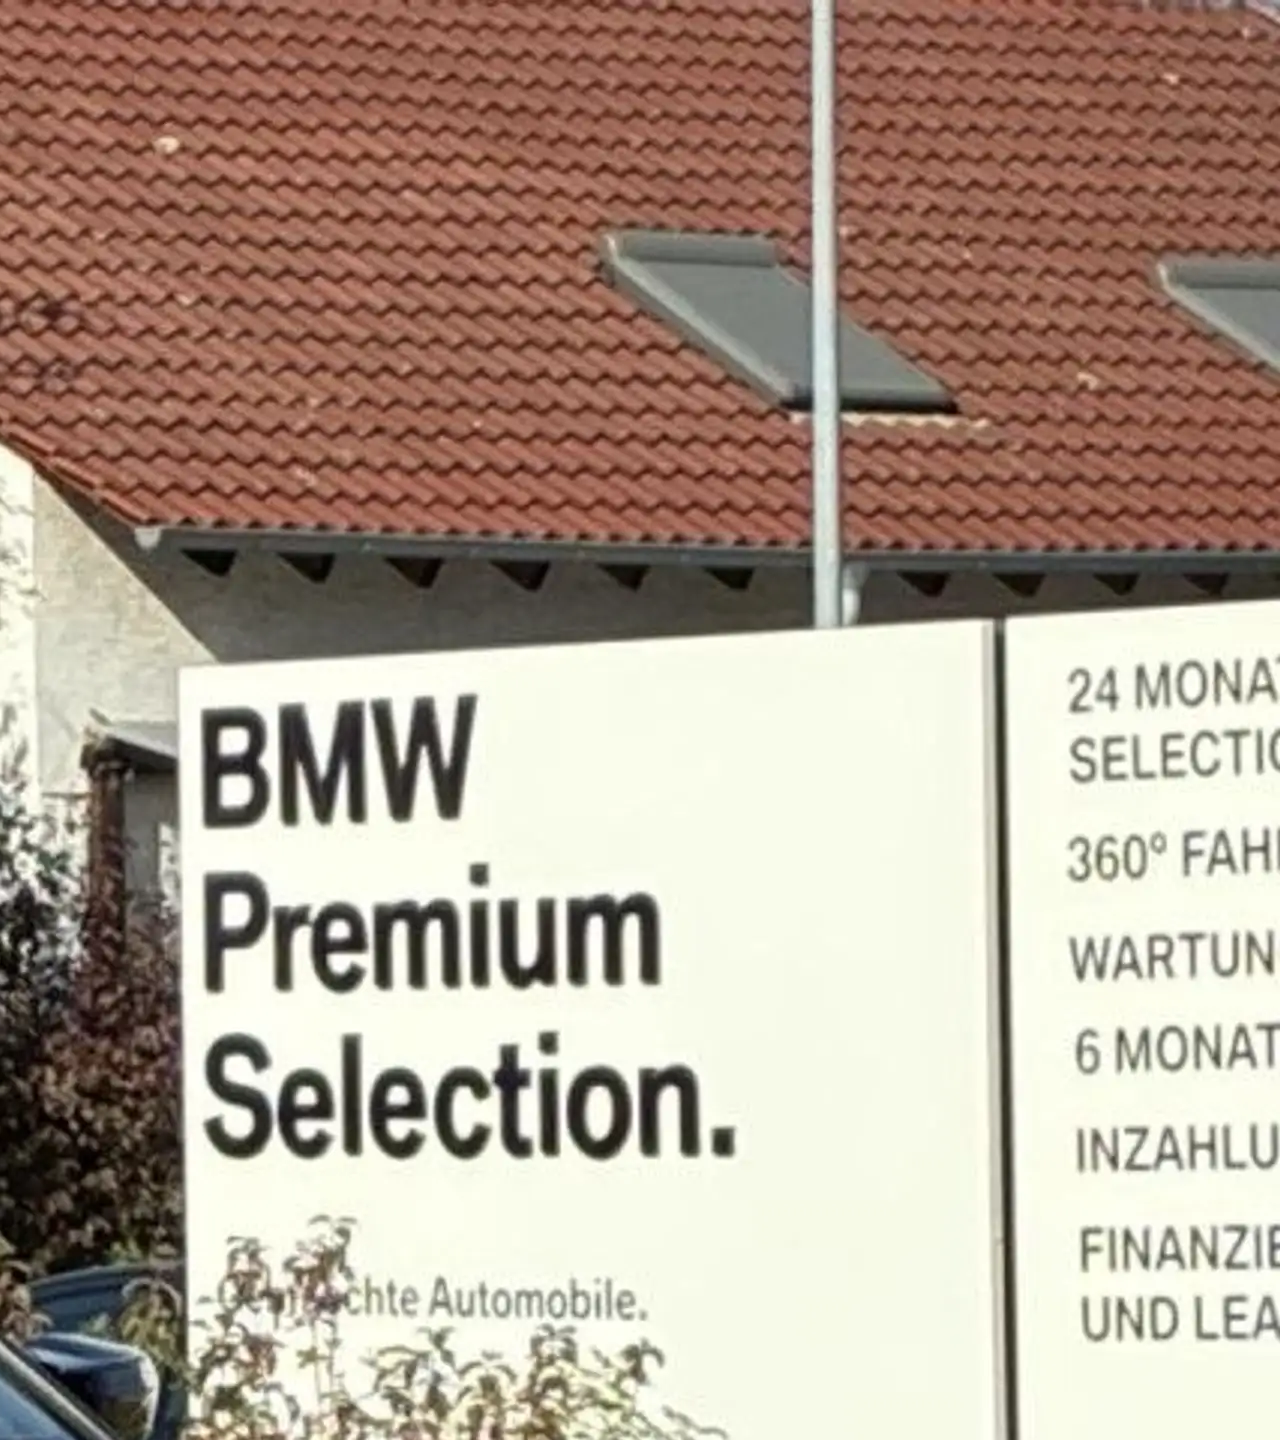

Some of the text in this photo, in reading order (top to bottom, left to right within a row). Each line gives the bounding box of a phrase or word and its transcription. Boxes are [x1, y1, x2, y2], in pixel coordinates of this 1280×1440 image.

[1067, 656, 1280, 714] 24 MONA
[201, 693, 478, 830] BMW
[1182, 828, 1280, 877] FAH
[203, 862, 661, 995] Premium
[1069, 930, 1275, 983] WARTUN
[1075, 1022, 1280, 1076] 6 MONAT
[203, 1030, 736, 1162] Selection.
[1076, 1122, 1280, 1172] INZAHLU
[428, 1275, 648, 1321] Automobile.
[1081, 1295, 1280, 1342] UND LEA
